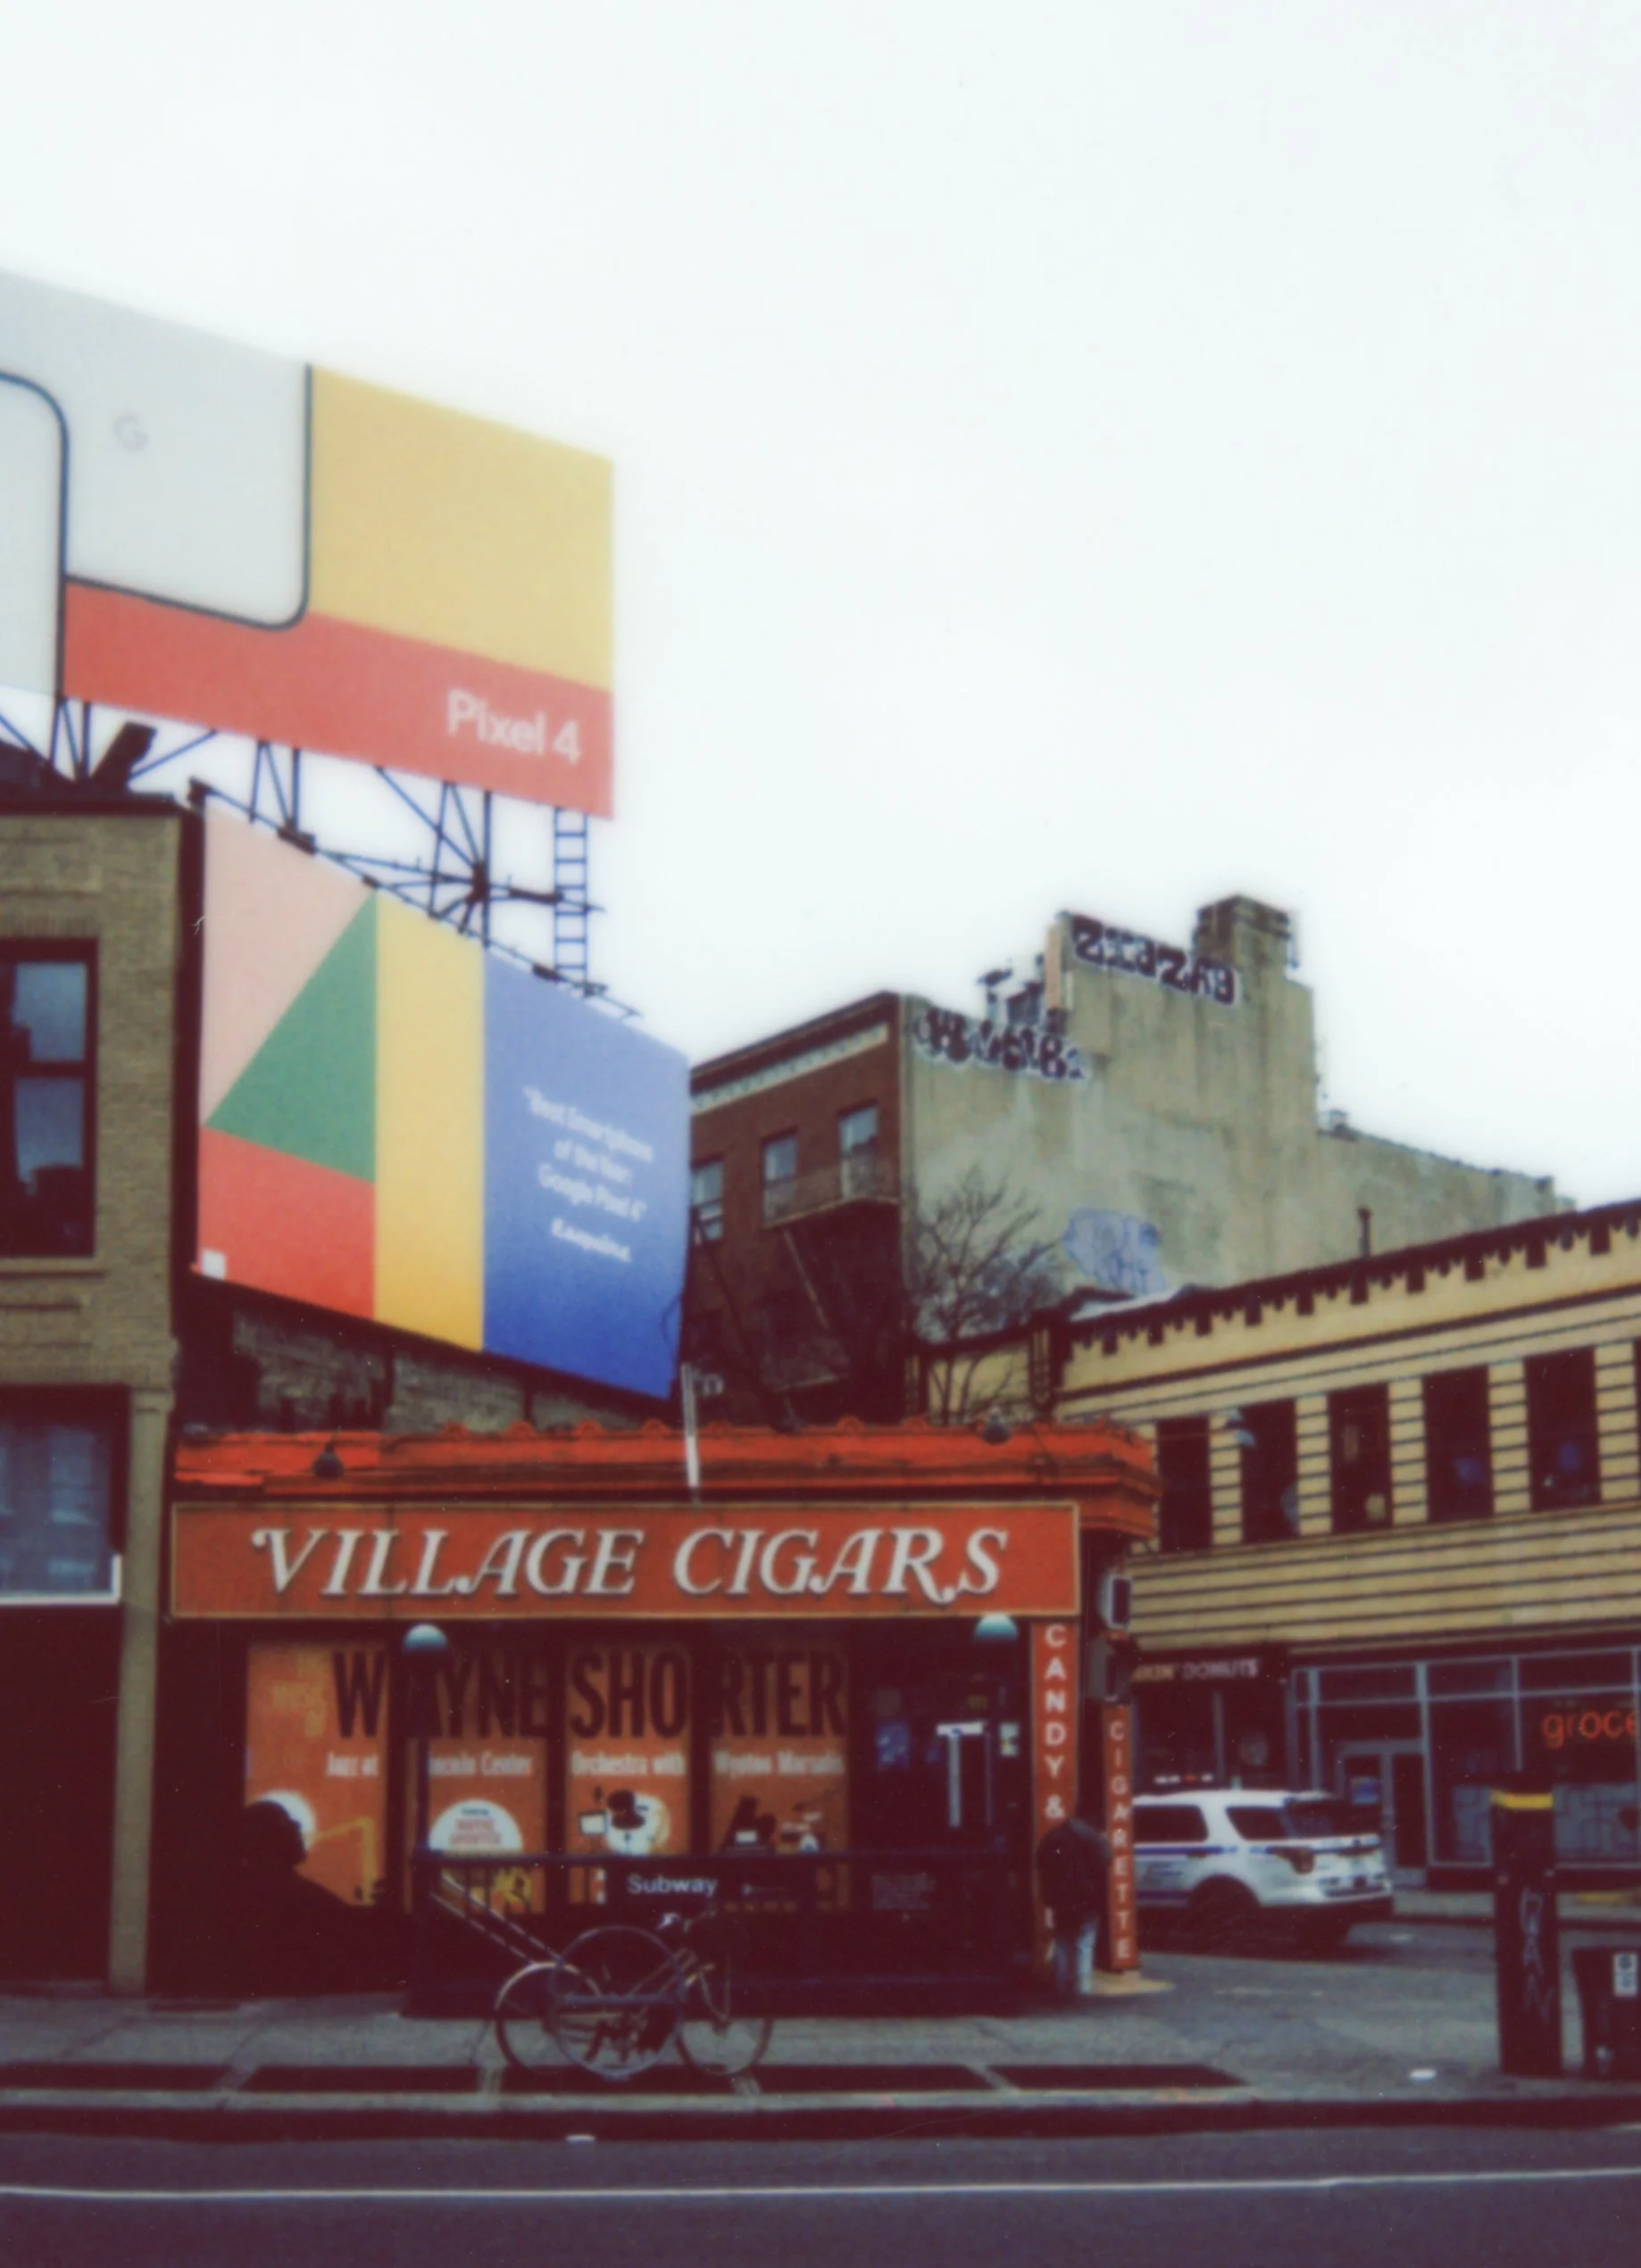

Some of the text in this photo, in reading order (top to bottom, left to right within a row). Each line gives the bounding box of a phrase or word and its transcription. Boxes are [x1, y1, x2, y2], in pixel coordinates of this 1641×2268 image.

[447, 688, 581, 767] Pixel 4
[251, 1526, 1008, 1604] VILLAGE CIGARS
[570, 1649, 846, 1740] SHORTER
[1181, 1657, 1259, 1681] DONUTS
[1043, 1624, 1068, 1820] CANDY &
[1109, 1720, 1133, 1960] CIGARETTE
[628, 1874, 718, 1898] Subway
